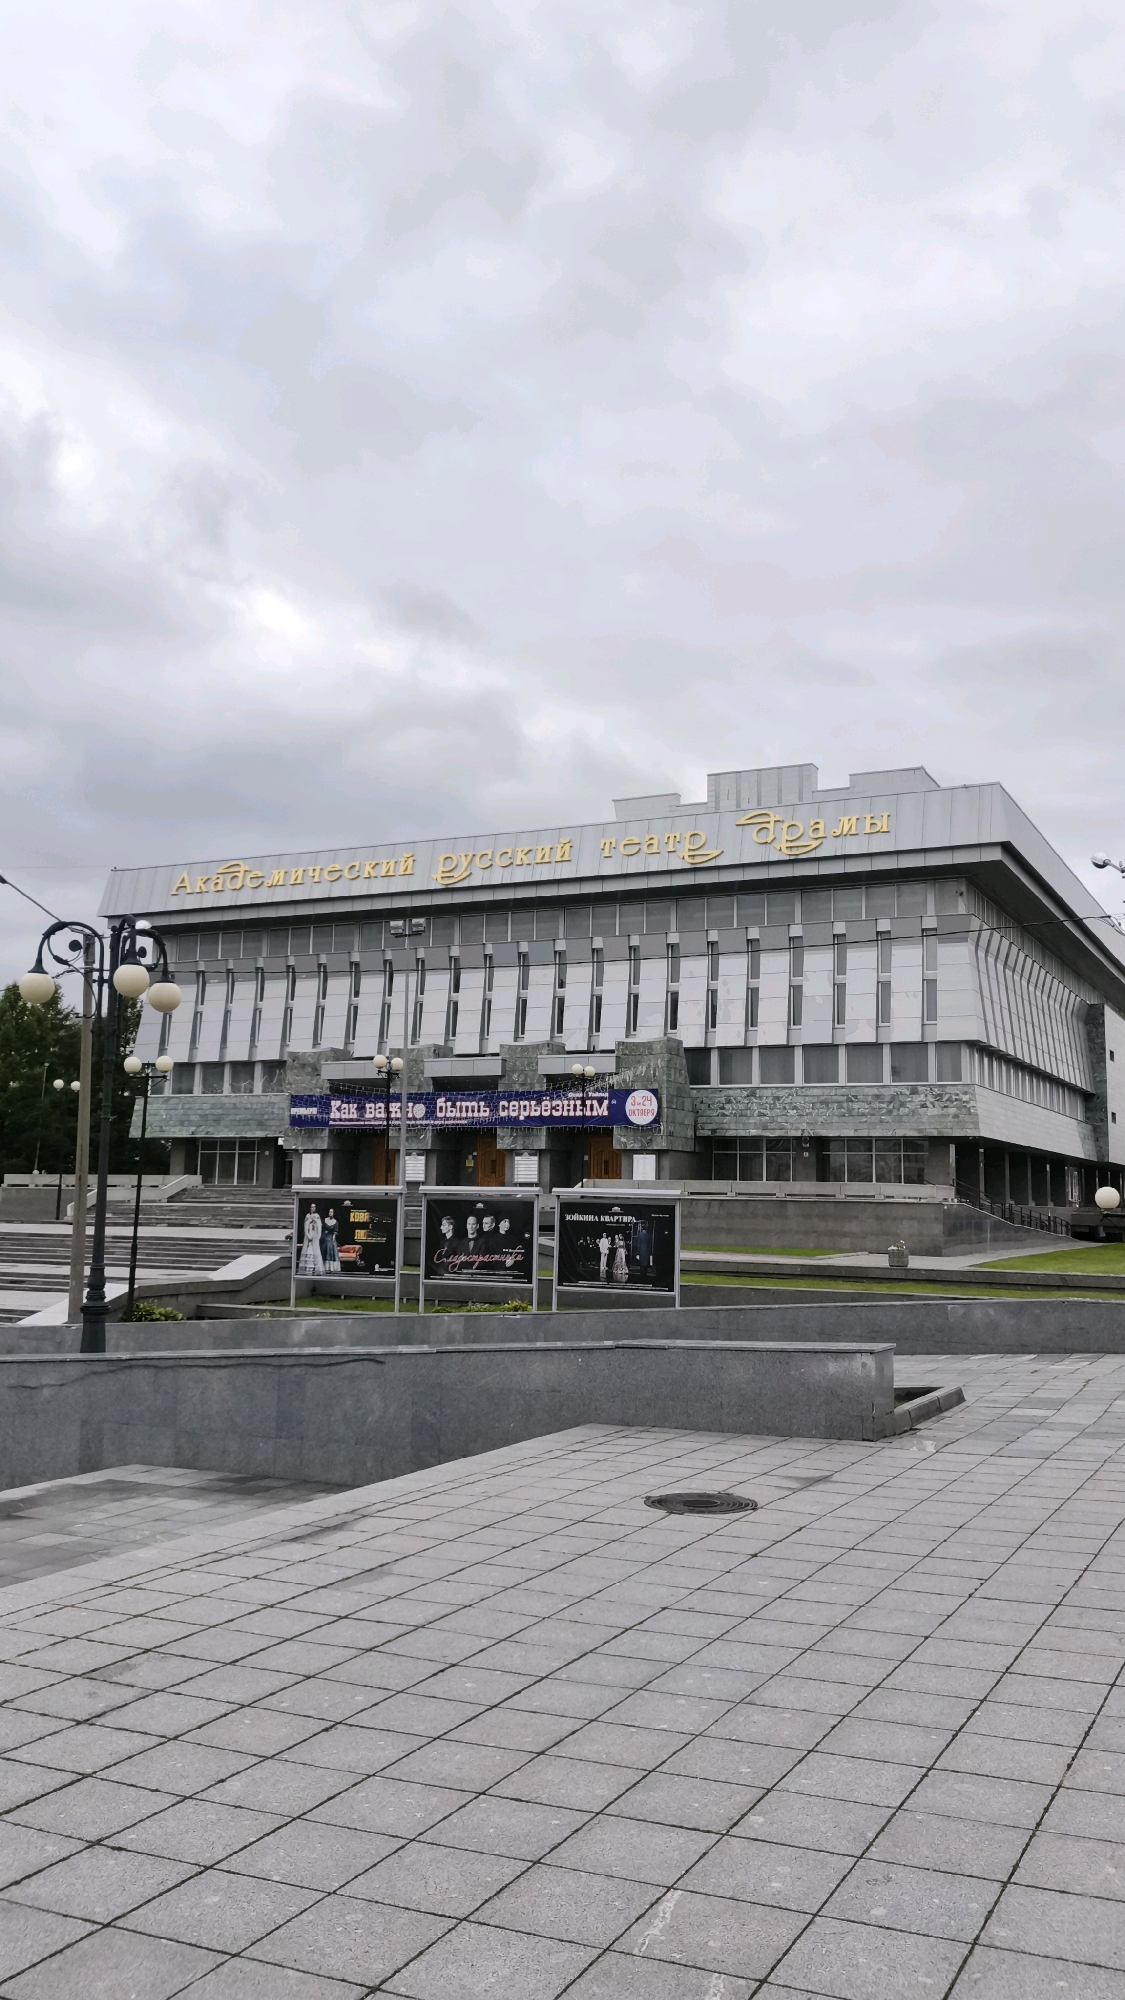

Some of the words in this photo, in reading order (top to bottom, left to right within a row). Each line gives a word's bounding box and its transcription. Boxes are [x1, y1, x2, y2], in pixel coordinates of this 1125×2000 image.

[170, 852, 415, 895] Академический
[431, 838, 573, 885] русский
[600, 830, 723, 865] театр
[735, 811, 890, 856] драмы
[630, 1095, 637, 1107] 3
[641, 1095, 653, 1107] 24
[330, 1100, 358, 1119] Как
[436, 1096, 490, 1119] быть
[499, 1096, 609, 1121] серьёзным
[628, 1108, 655, 1117] ОКТЯБРЯ
[564, 1213, 599, 1222] ЗОЙКИНА
[600, 1214, 637, 1223] КВАРТИРА
